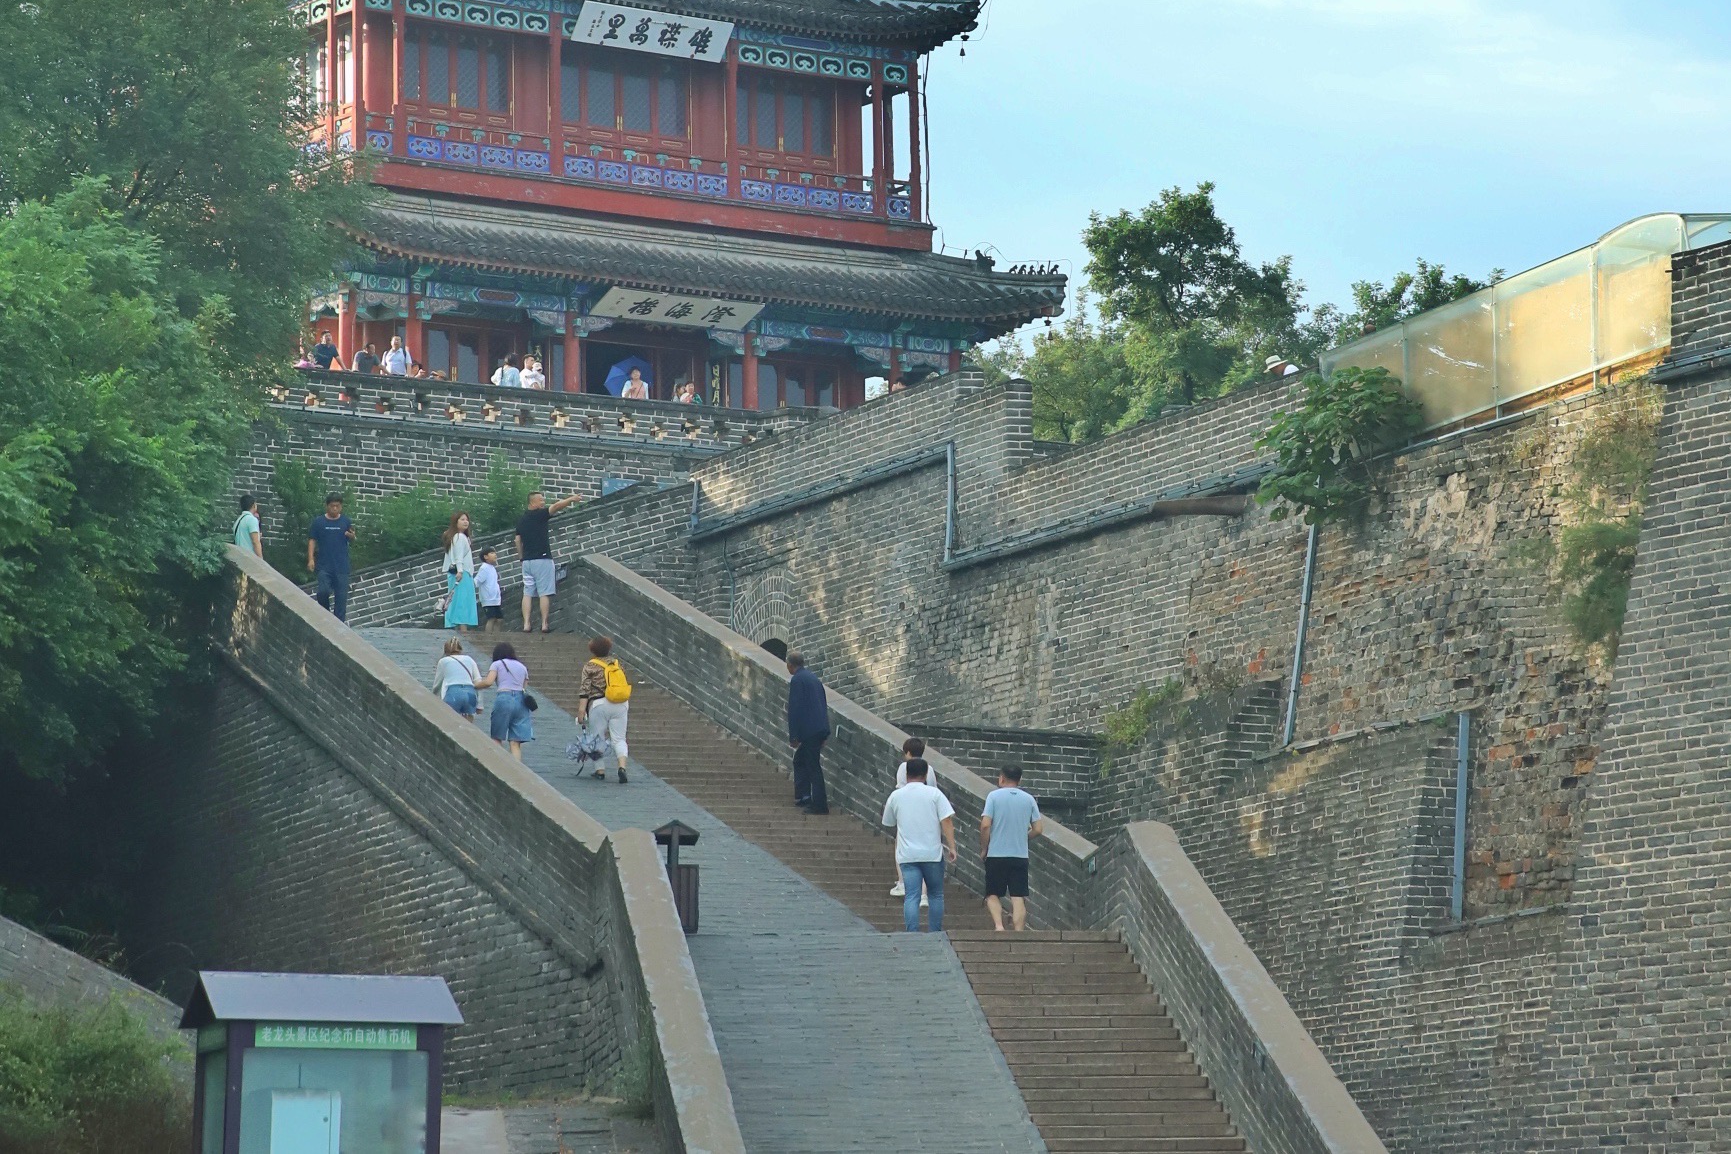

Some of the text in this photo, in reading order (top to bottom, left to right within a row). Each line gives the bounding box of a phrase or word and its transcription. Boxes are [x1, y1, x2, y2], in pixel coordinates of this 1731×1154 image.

[261, 1026, 411, 1045] 老龙头景区纪念币自动售币机
